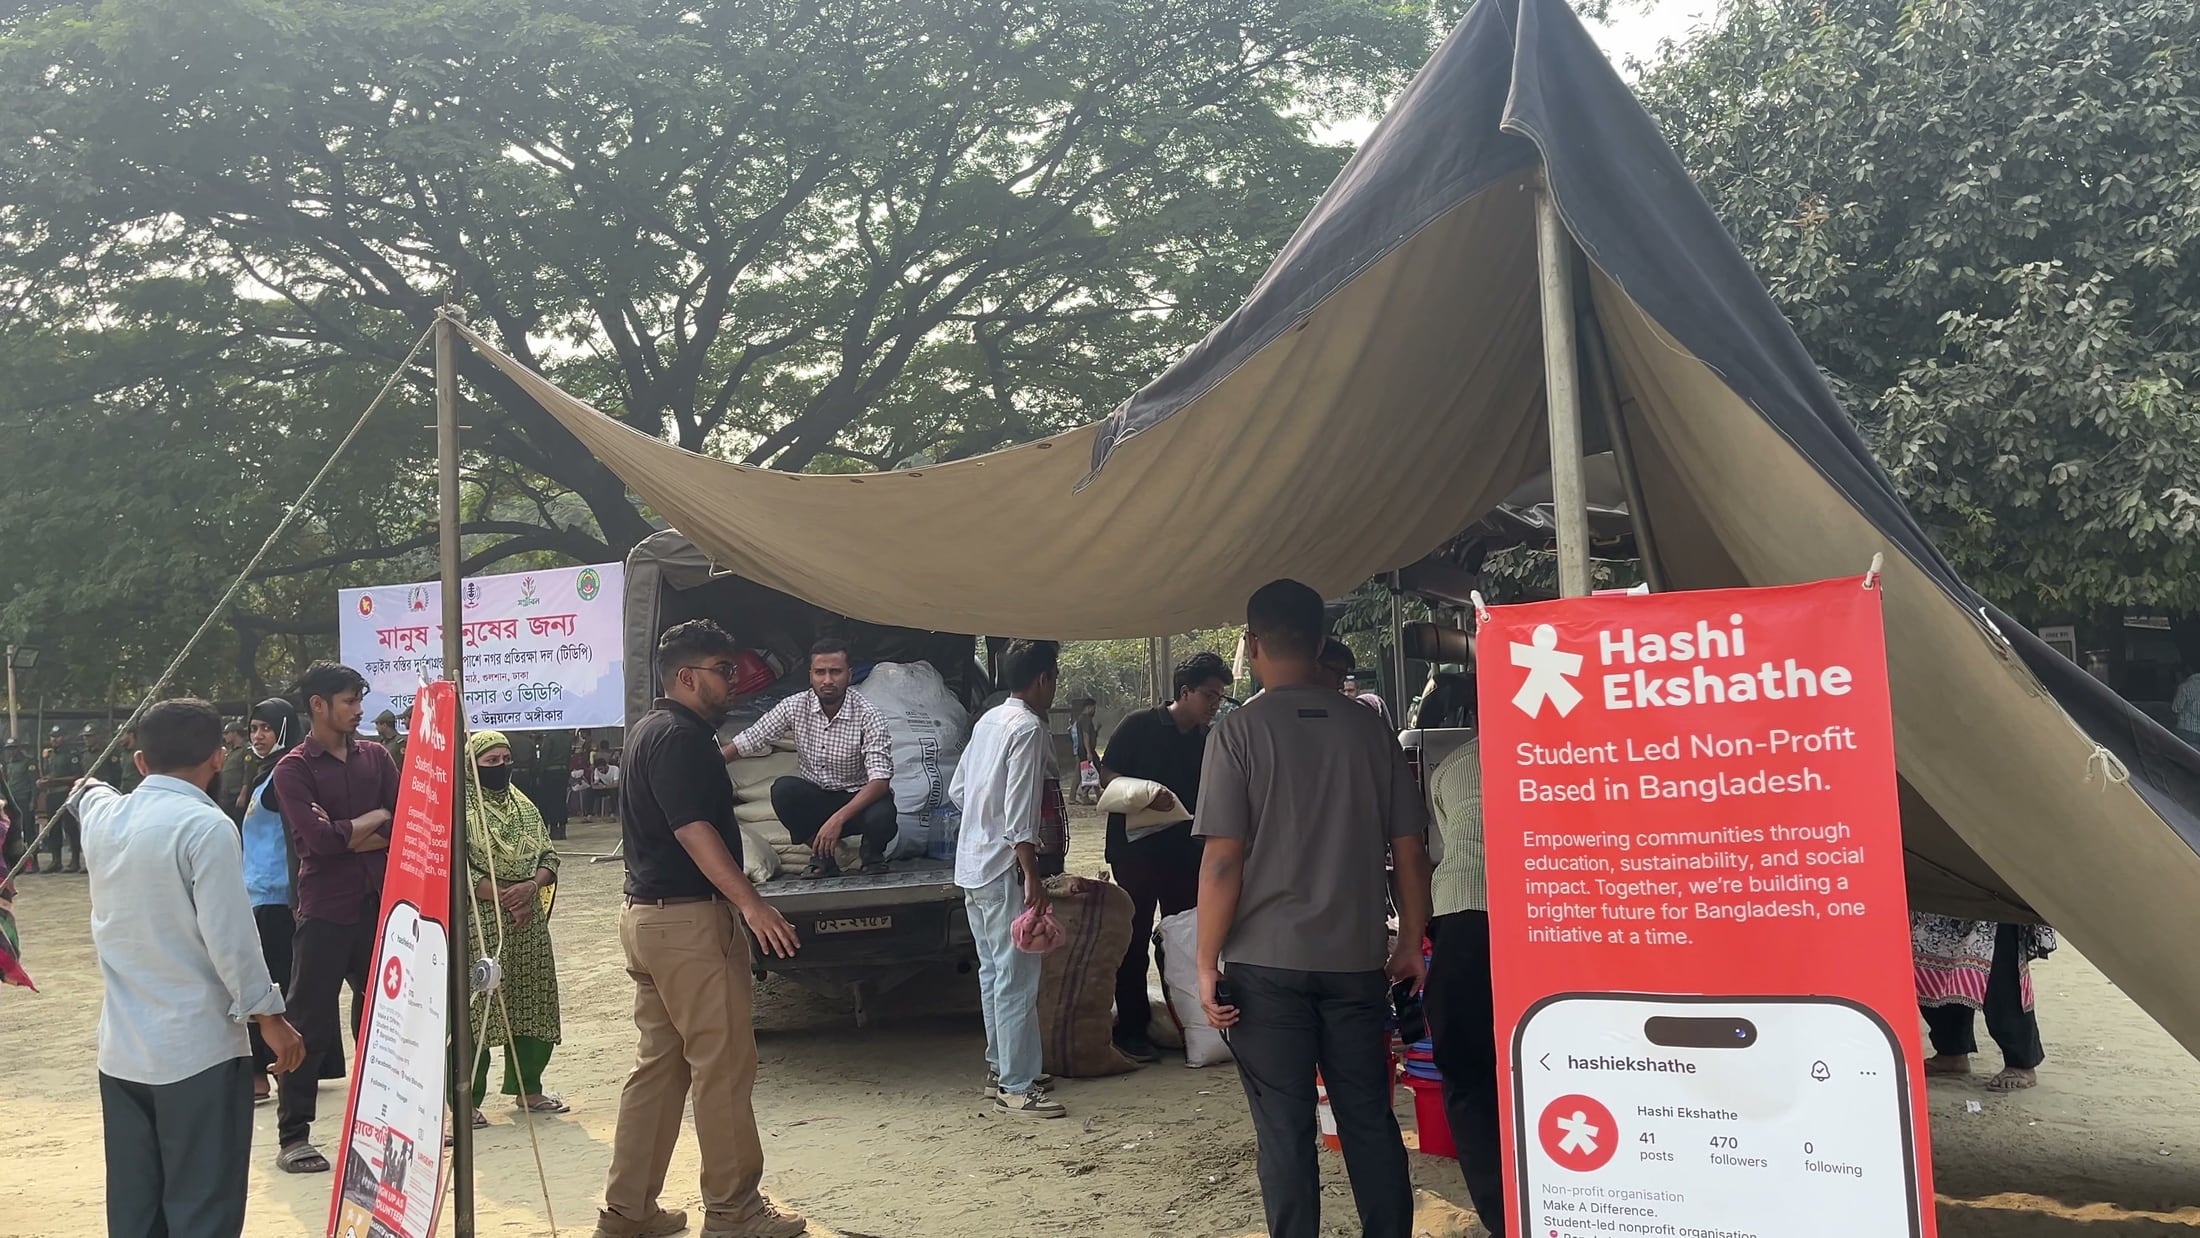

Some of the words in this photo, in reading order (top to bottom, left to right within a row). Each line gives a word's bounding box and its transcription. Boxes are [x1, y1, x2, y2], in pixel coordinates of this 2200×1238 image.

[376, 626, 429, 652] মানুষ
[436, 619, 519, 649] নুষের
[526, 614, 577, 637] জন্য
[1600, 613, 1746, 666] Hashi
[484, 652, 501, 666] নগর
[504, 648, 537, 664] প্রতিরক্ষা
[540, 649, 553, 662] দল
[556, 643, 592, 664] (টিডিপি)
[512, 671, 529, 680] ঢাকা
[1603, 658, 1853, 710] Ekshathe
[464, 689, 497, 704] নসার
[502, 689, 513, 702] ও
[518, 682, 563, 702] ভিডিপি
[471, 714, 479, 724] ও
[524, 707, 563, 722] অঙ্গীকার
[1516, 741, 1618, 766] Student
[1626, 735, 1681, 763] Led
[1690, 726, 1857, 760] Non-Profit
[1518, 777, 1596, 802] Based
[1604, 777, 1629, 801] in
[1639, 767, 1831, 803] Bangladesh.
[1523, 829, 1631, 851] Empowering
[1636, 825, 1764, 847] communities
[1769, 821, 1850, 846] through
[1524, 854, 1614, 874] education,
[1620, 850, 1755, 872] sustainability,
[1761, 848, 1799, 868] and
[1805, 846, 1864, 866] social
[1525, 879, 1591, 898] impact.
[1595, 878, 1682, 899] Together,
[1688, 876, 1743, 894] we’re
[1749, 874, 1830, 896] building
[1837, 877, 1849, 892] a
[1527, 902, 1597, 925] brighter
[1601, 900, 1656, 921] future
[1660, 901, 1688, 921] for
[1694, 900, 1821, 923] Bangladesh,
[1827, 900, 1866, 917] one
[1528, 926, 1602, 945] initiative
[1607, 928, 1624, 945] at
[1629, 931, 1641, 946] a
[1644, 927, 1694, 946] time.
[1567, 1054, 1697, 1075] hashiekshathe
[1637, 1106, 1674, 1120] Hashi
[1677, 1106, 1739, 1122] Ekshathe
[1639, 1132, 1656, 1146] 41
[1709, 1136, 1739, 1150] 470
[1804, 1142, 1813, 1155] 0
[1640, 1150, 1675, 1164] posts
[1710, 1153, 1768, 1169] followers
[1804, 1160, 1863, 1178] following
[1542, 1184, 1604, 1198] Non-profit
[1608, 1188, 1685, 1203] organisation
[1543, 1200, 1575, 1212] Make
[1578, 1202, 1588, 1213] A
[1590, 1202, 1658, 1218] Difference.
[1544, 1216, 1615, 1231] Student-led
[1618, 1222, 1675, 1236] nonprofit
[1679, 1227, 1757, 1238] organisation
